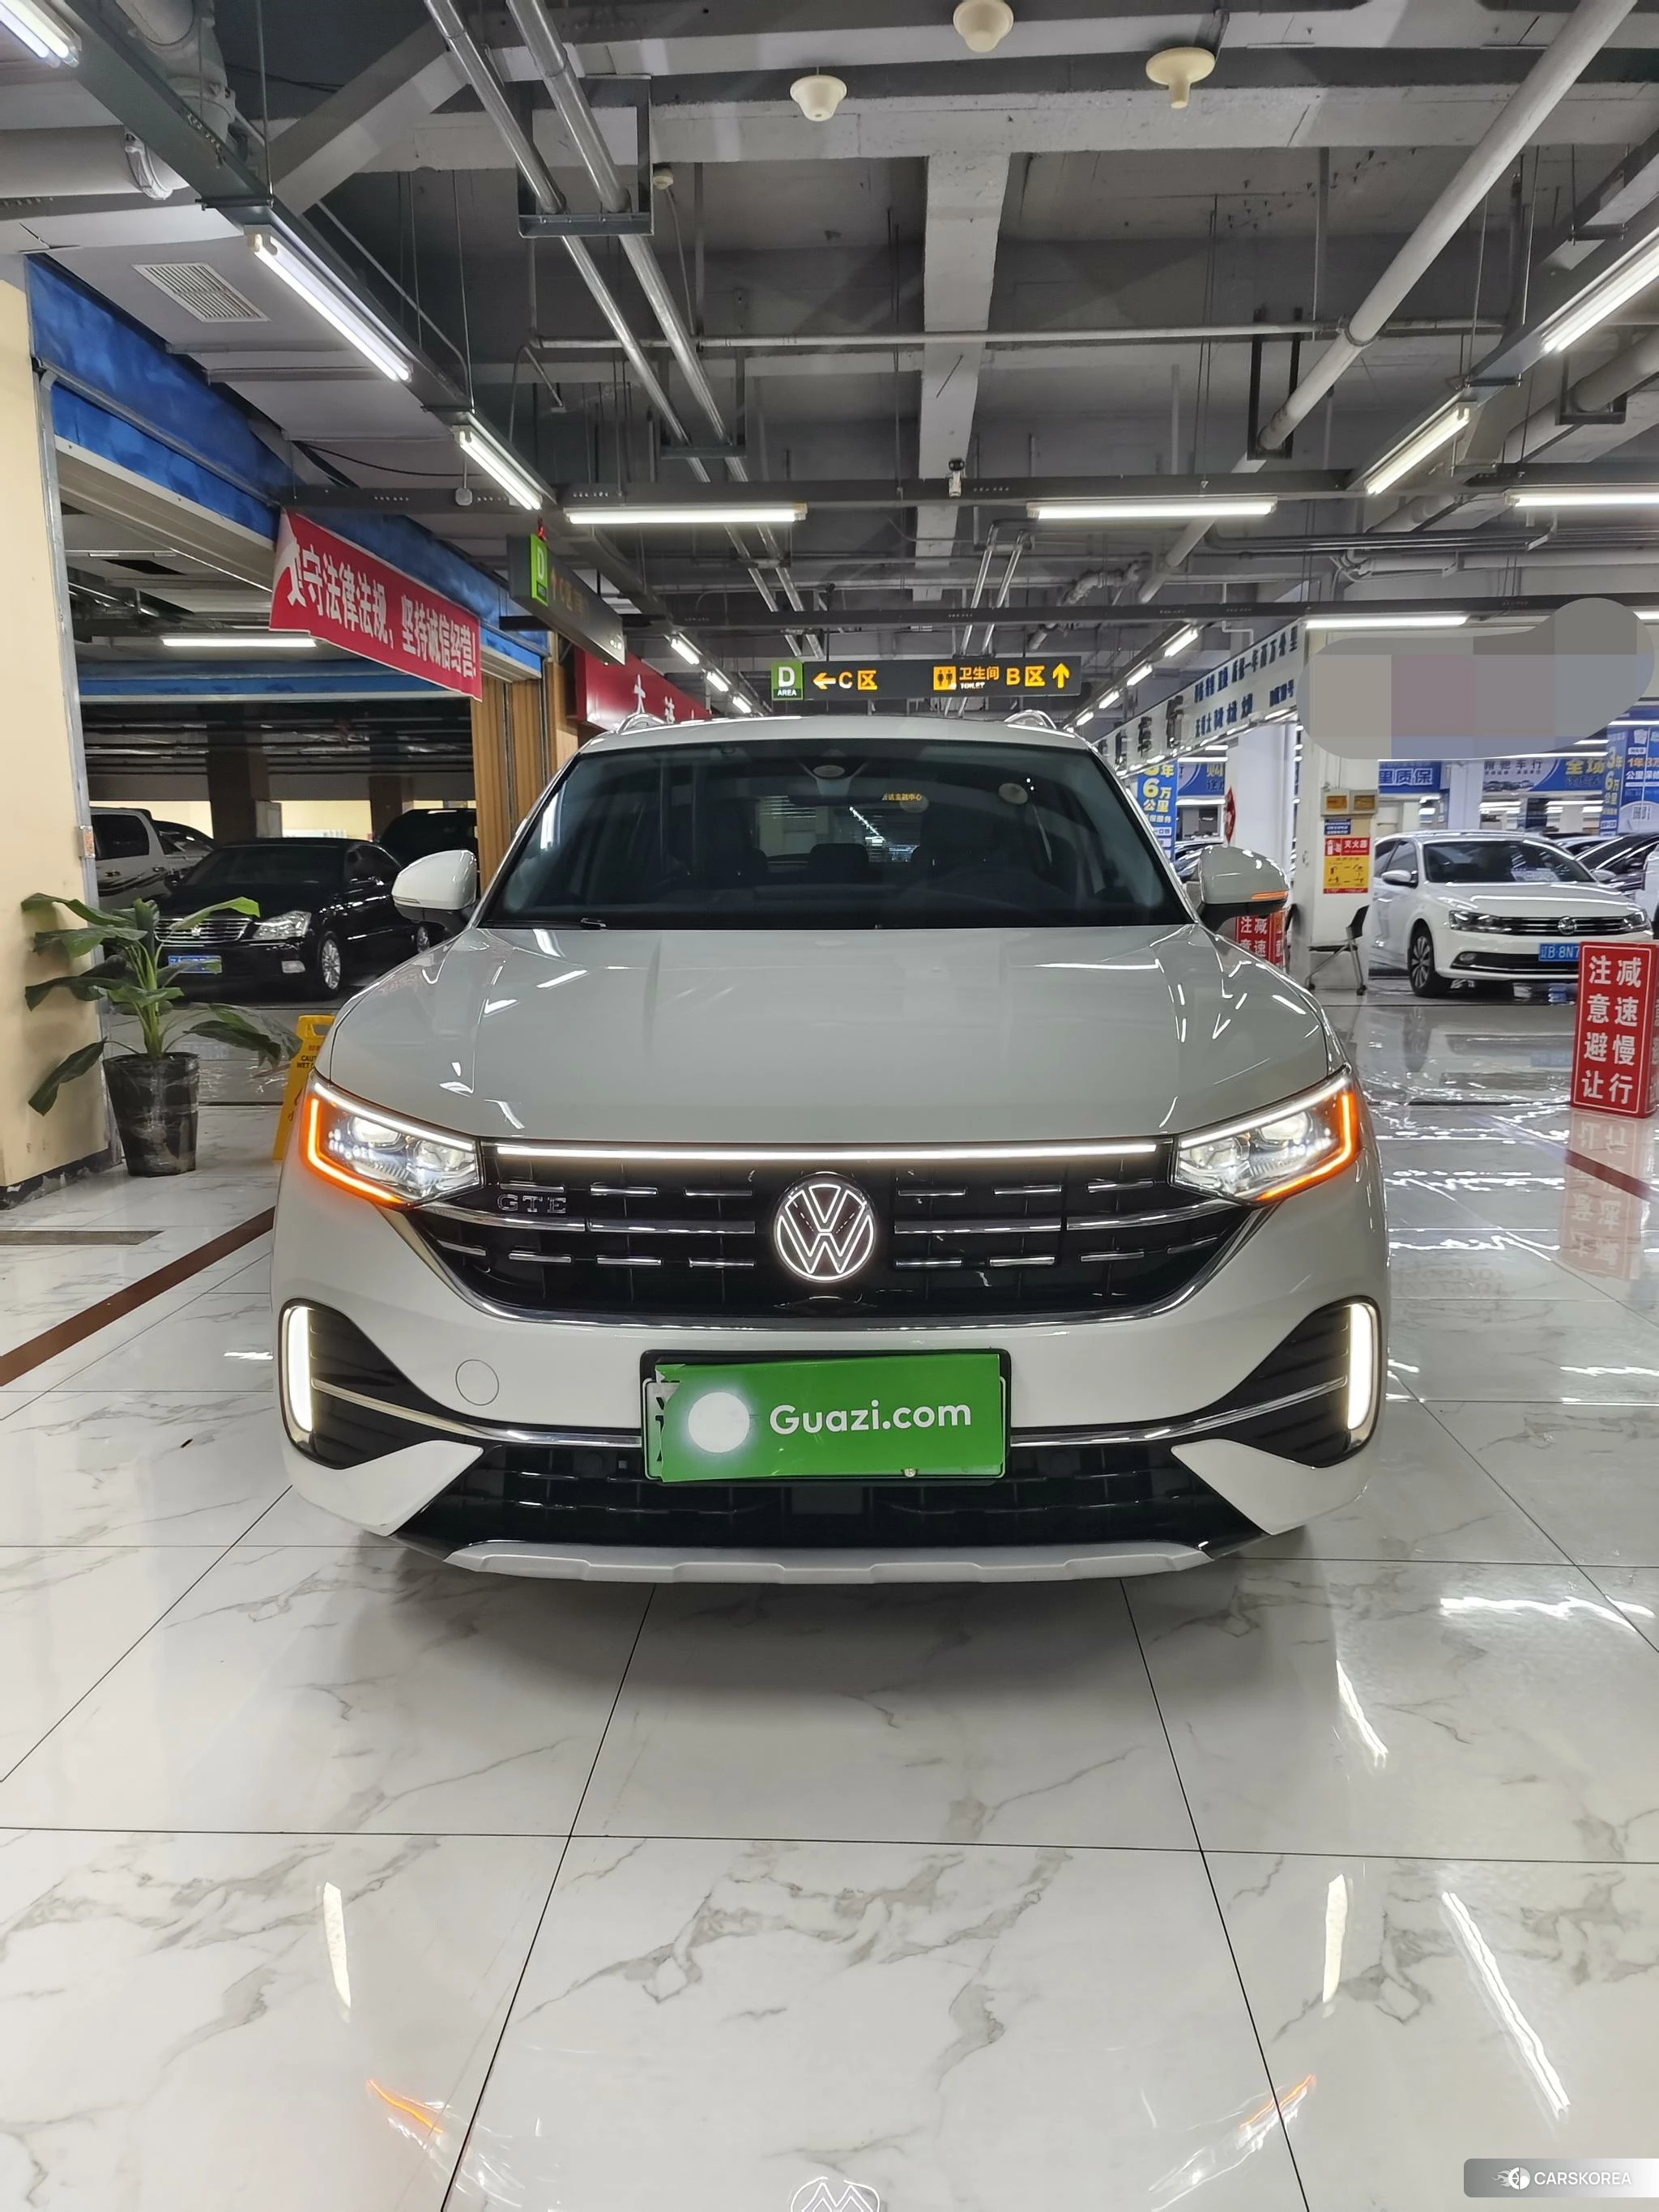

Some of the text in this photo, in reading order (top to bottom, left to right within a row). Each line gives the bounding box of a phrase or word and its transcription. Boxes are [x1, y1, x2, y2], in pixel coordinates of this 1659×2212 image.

[537, 545, 545, 580] D
[778, 666, 795, 688] D
[959, 666, 1000, 680] 卫生间
[777, 688, 797, 697] AREA
[1142, 778, 1171, 799] 6万
[1143, 799, 1169, 812] 公里
[497, 1194, 567, 1214] GTE
[769, 1399, 972, 1436] Guazi.com
